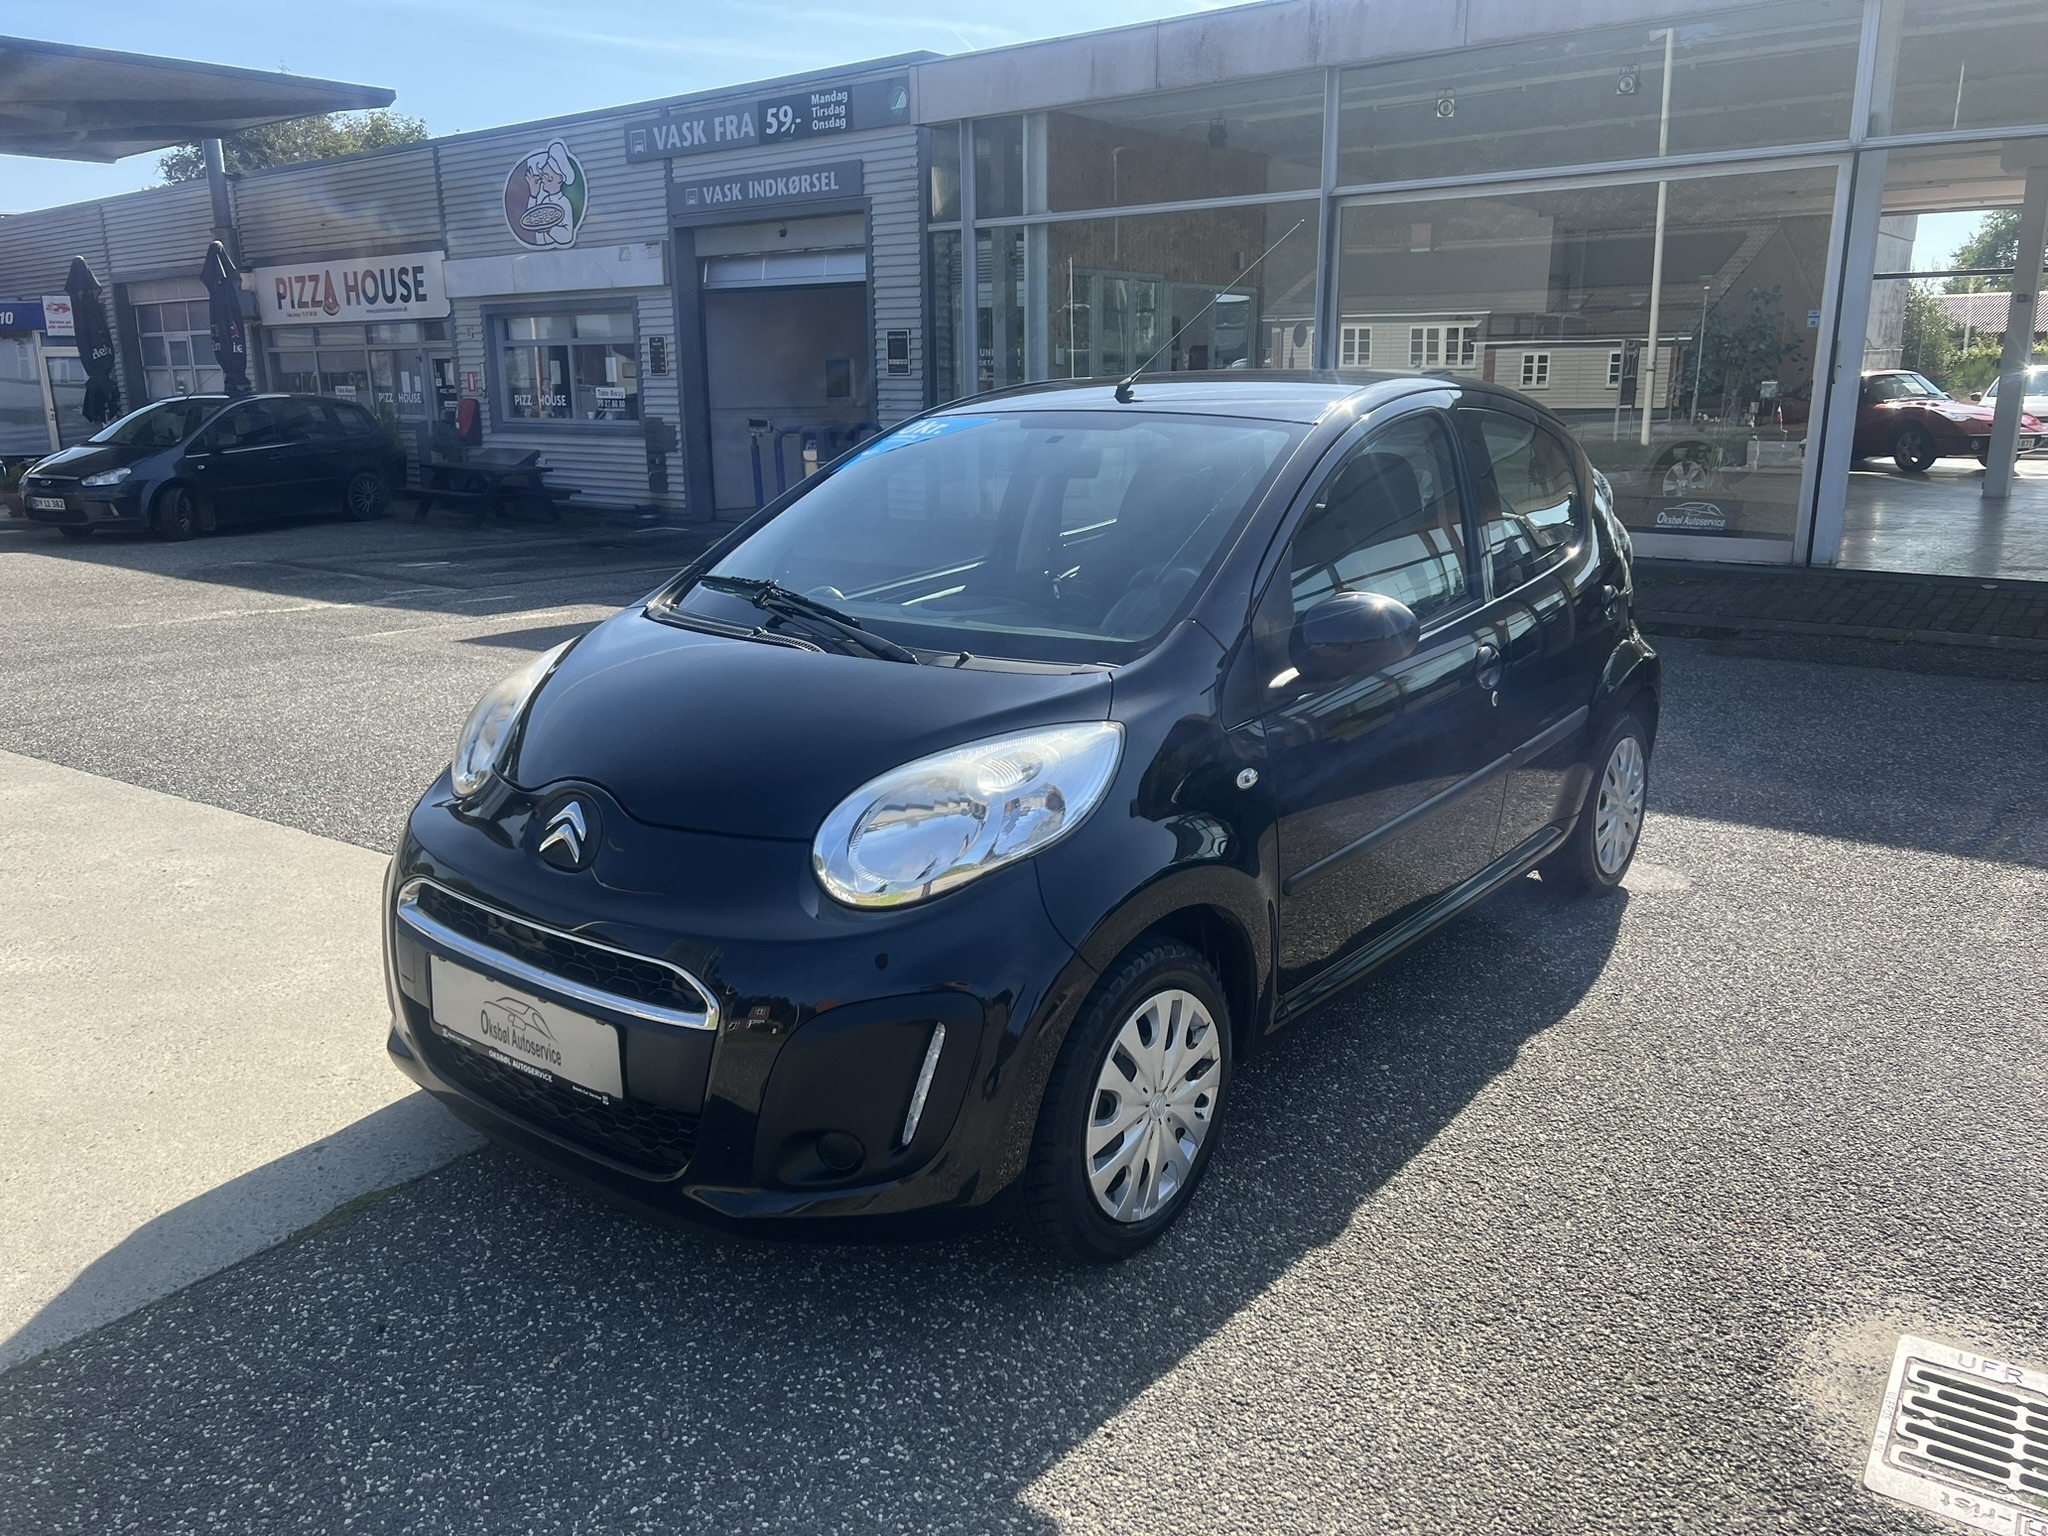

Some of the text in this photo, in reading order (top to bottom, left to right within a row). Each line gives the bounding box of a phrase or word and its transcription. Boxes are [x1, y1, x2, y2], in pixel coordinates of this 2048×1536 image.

[811, 90, 848, 105] Mandag
[811, 104, 846, 118] Tirsdag
[653, 105, 801, 150] VASK FRA 59,-
[812, 116, 847, 131] Onsdag
[703, 171, 839, 204] VASK INDKØRSEL
[343, 265, 428, 306] HOUSE
[398, 392, 422, 403] HOUSE
[538, 394, 567, 406] HOUSE
[1682, 515, 1726, 527] Autoservice
[480, 1008, 562, 1067] Oksbøl Autoservice
[488, 1050, 553, 1083] OKSBØL AUTOSERVICE
[1957, 1352, 2025, 1384] UFR
